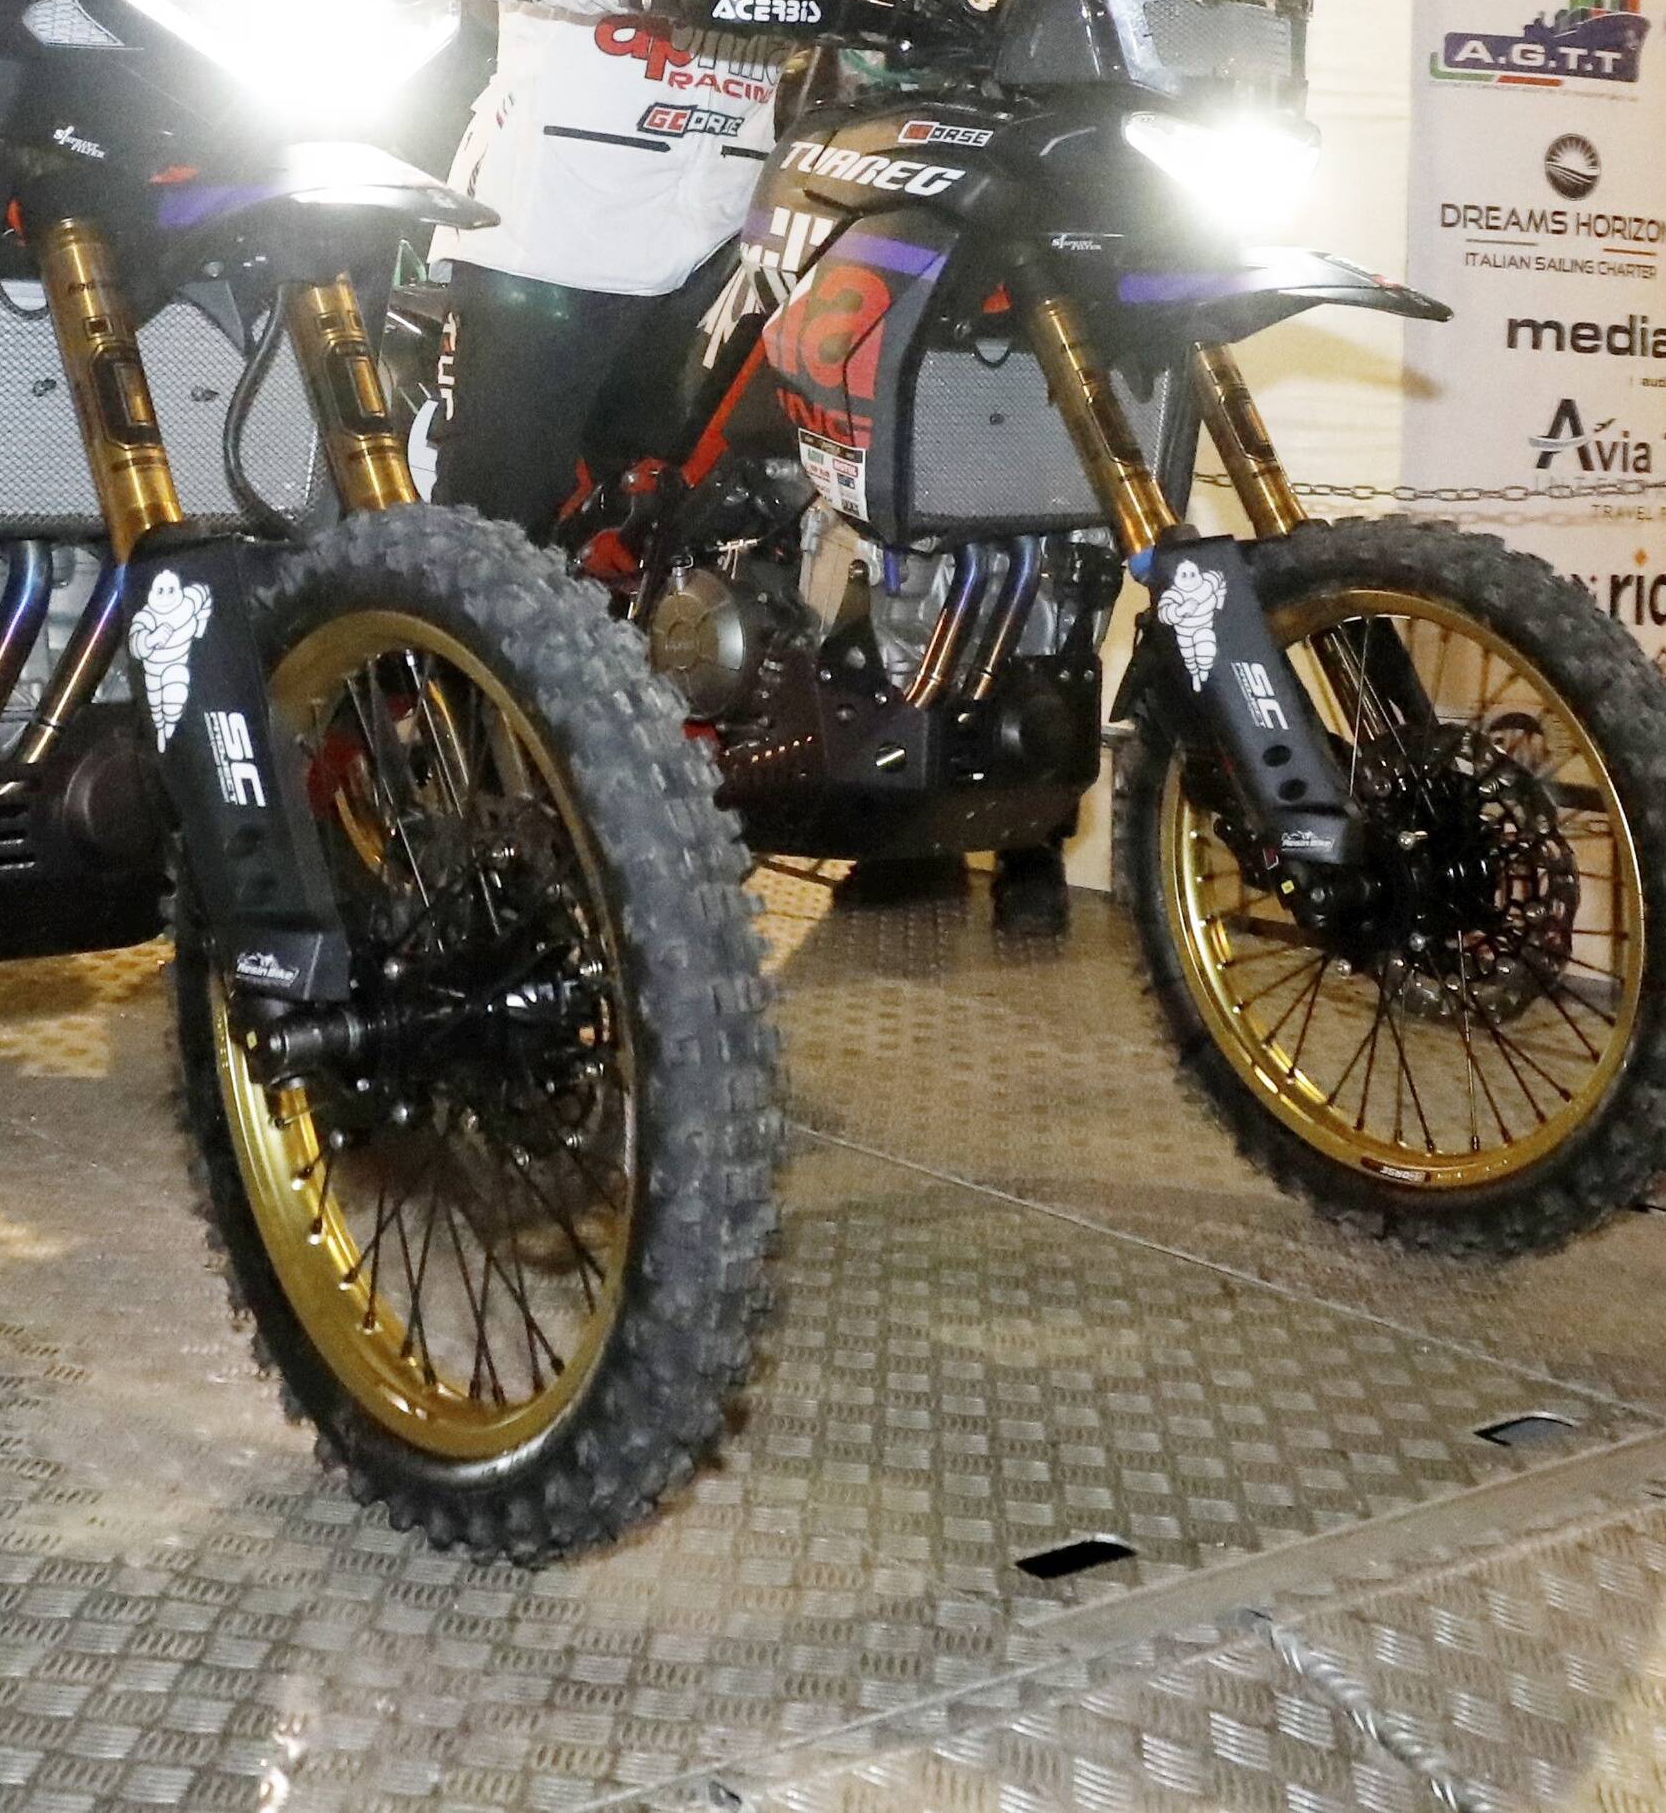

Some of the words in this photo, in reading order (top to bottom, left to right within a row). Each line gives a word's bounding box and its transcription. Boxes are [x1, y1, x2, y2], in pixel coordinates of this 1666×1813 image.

[668, 71, 773, 104] RACIN
[779, 140, 966, 197] TUAREG
[1441, 203, 1568, 236] DREAMS
[1465, 252, 1531, 271] ITALIAN
[1535, 256, 1595, 276] SAILING
[1599, 260, 1658, 281] CHARTER
[1536, 398, 1652, 473] Avia
[217, 710, 267, 808] SC
